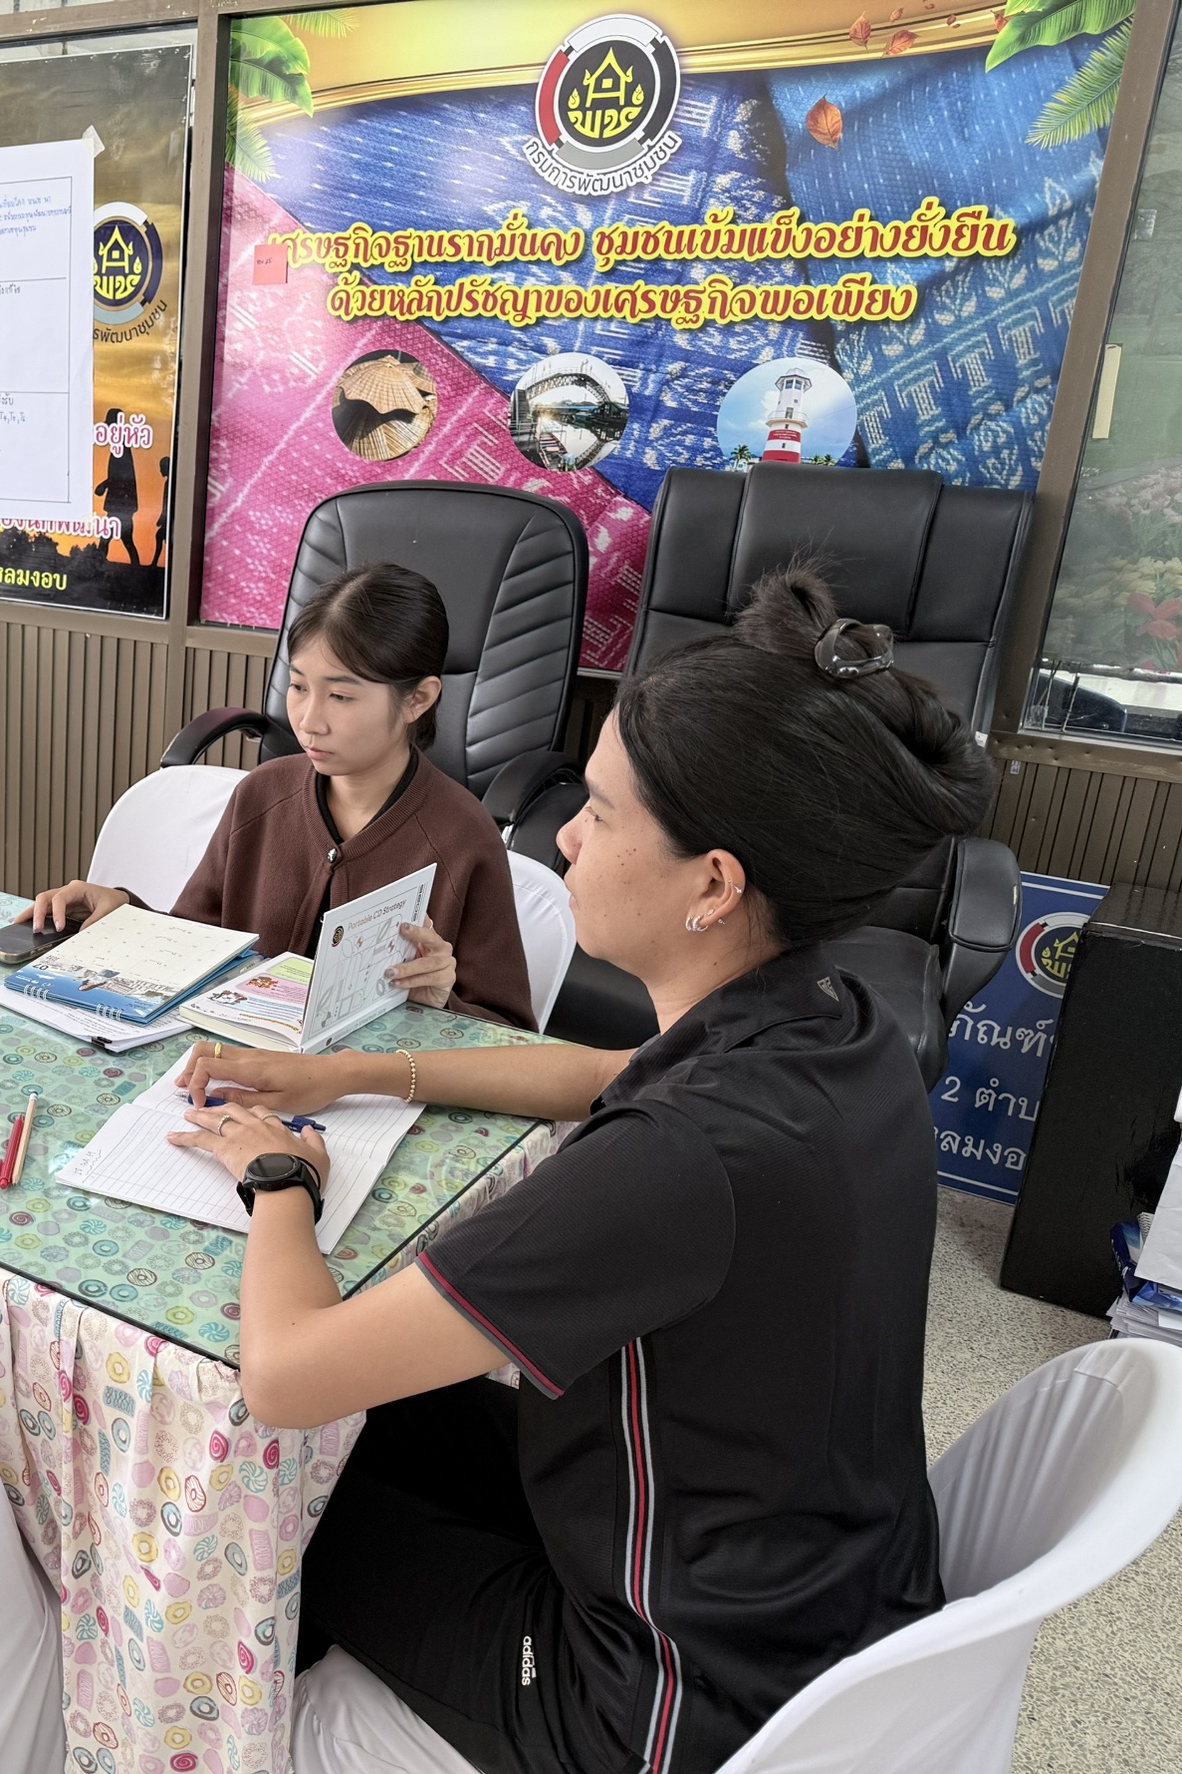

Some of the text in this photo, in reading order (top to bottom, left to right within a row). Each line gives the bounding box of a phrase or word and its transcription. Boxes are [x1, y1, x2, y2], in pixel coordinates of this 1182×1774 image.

[526, 134, 679, 192] กรมการพัฒนาชุมชน
[271, 201, 1012, 268] ศรษฐกิจฐานรากมั่นคง ชุมชนเข้มแข็งอย่างยั่งยืน
[331, 276, 913, 324] ด้วยหลักปรัชญาของเศรษฐกิจพอเพียง
[95, 413, 151, 455] อยู่หัว
[348, 914, 373, 930] Portable
[373, 910, 383, 919] CD
[383, 899, 406, 915] Strategy
[948, 1001, 1056, 1057] ภัณฑ์
[940, 1076, 961, 1103] 2
[934, 1128, 1027, 1171] ลมงอ
[522, 1635, 534, 1686] adidas
